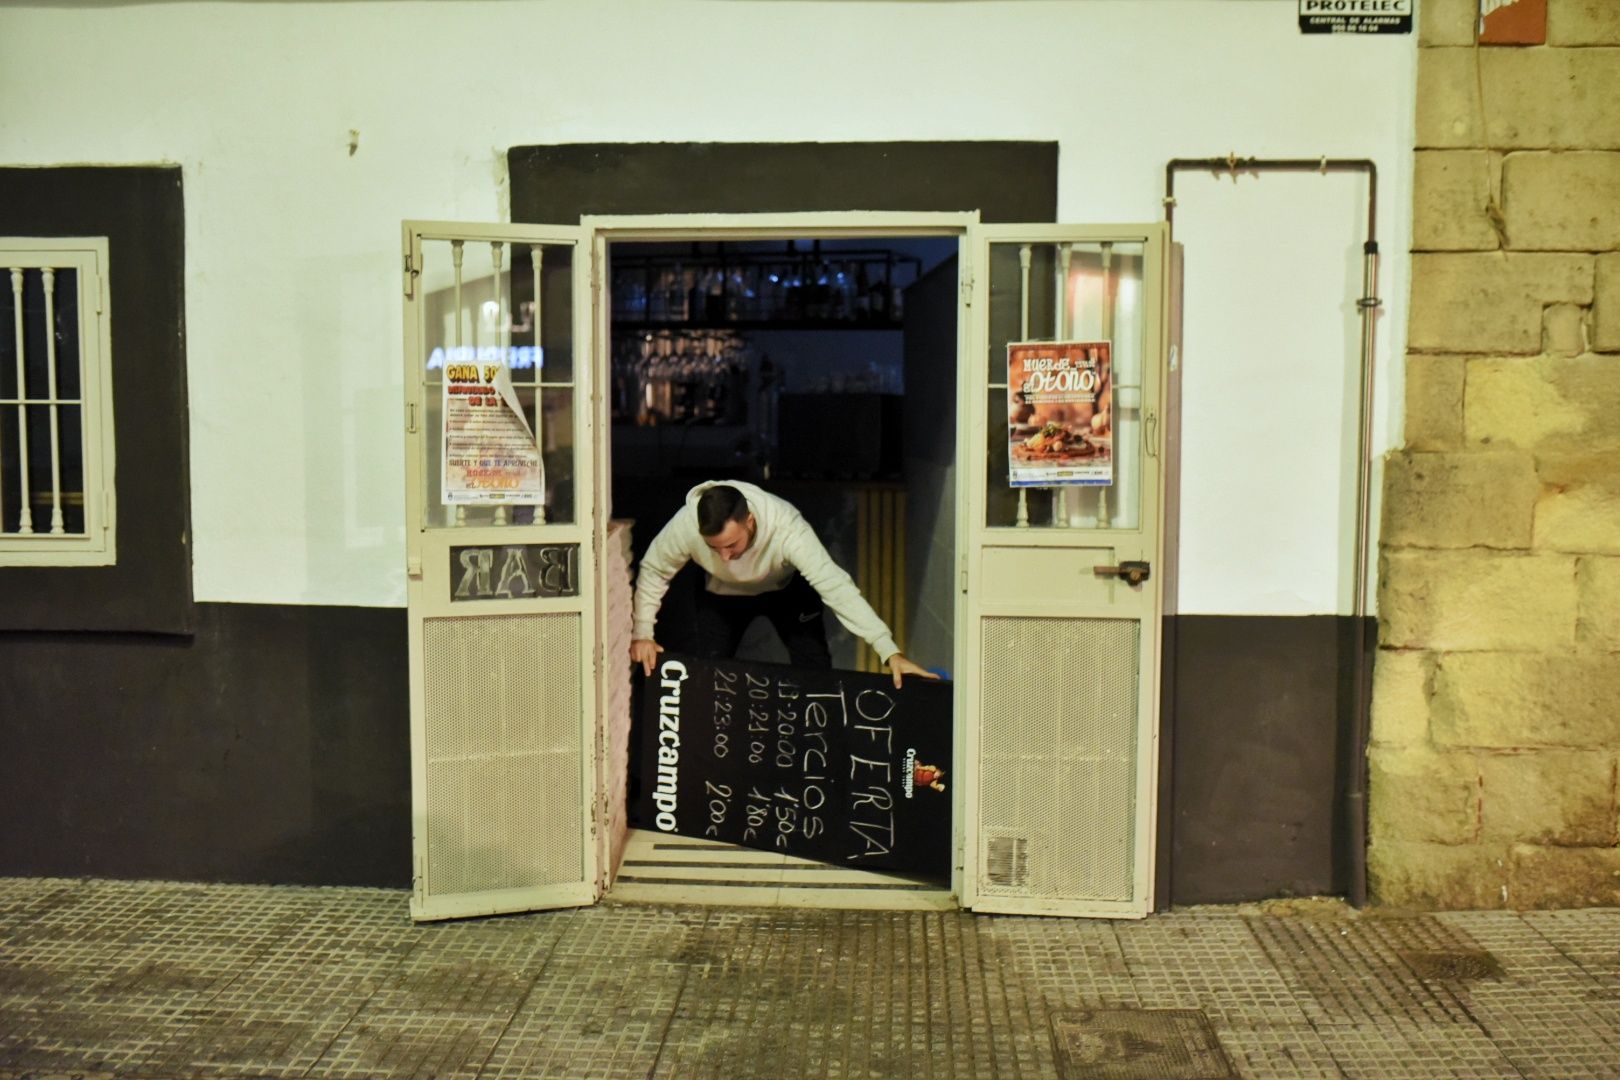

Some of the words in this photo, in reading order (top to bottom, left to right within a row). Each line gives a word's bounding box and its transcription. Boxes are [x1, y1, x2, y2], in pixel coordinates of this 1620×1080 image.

[1306, 0, 1406, 11] PROTELEC
[447, 364, 480, 384] GANA
[652, 660, 689, 832] Cruzcampo
[802, 680, 847, 840] Tercios
[847, 689, 896, 860] OFERTA
[905, 748, 916, 799] Cruzcampo
